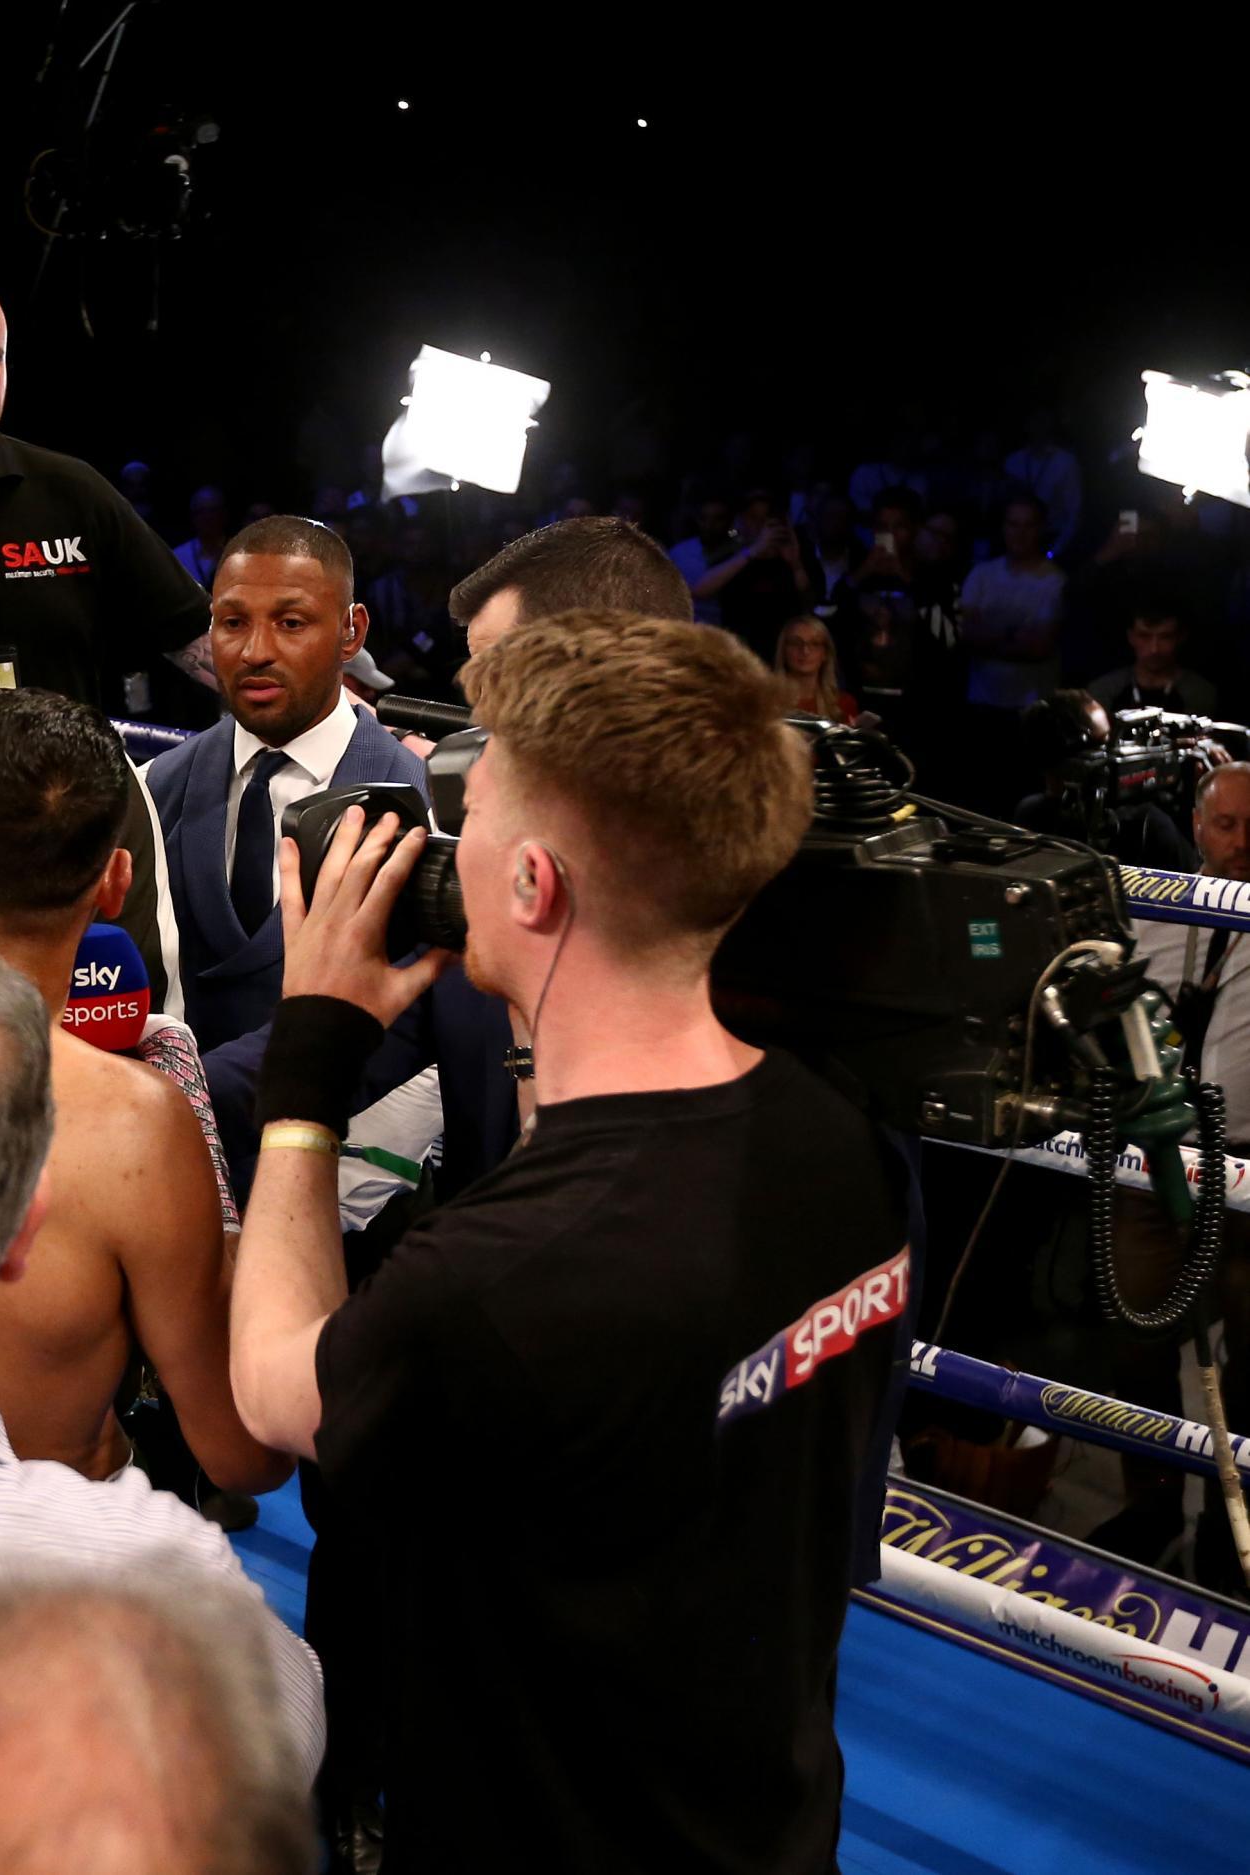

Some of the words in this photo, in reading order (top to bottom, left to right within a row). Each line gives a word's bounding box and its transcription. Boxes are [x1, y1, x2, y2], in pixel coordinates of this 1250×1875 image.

[2, 536, 87, 568] SAUK
[968, 922, 997, 936] EXT
[74, 961, 121, 991] sky
[62, 1001, 139, 1026] sports
[717, 1348, 779, 1419] sky
